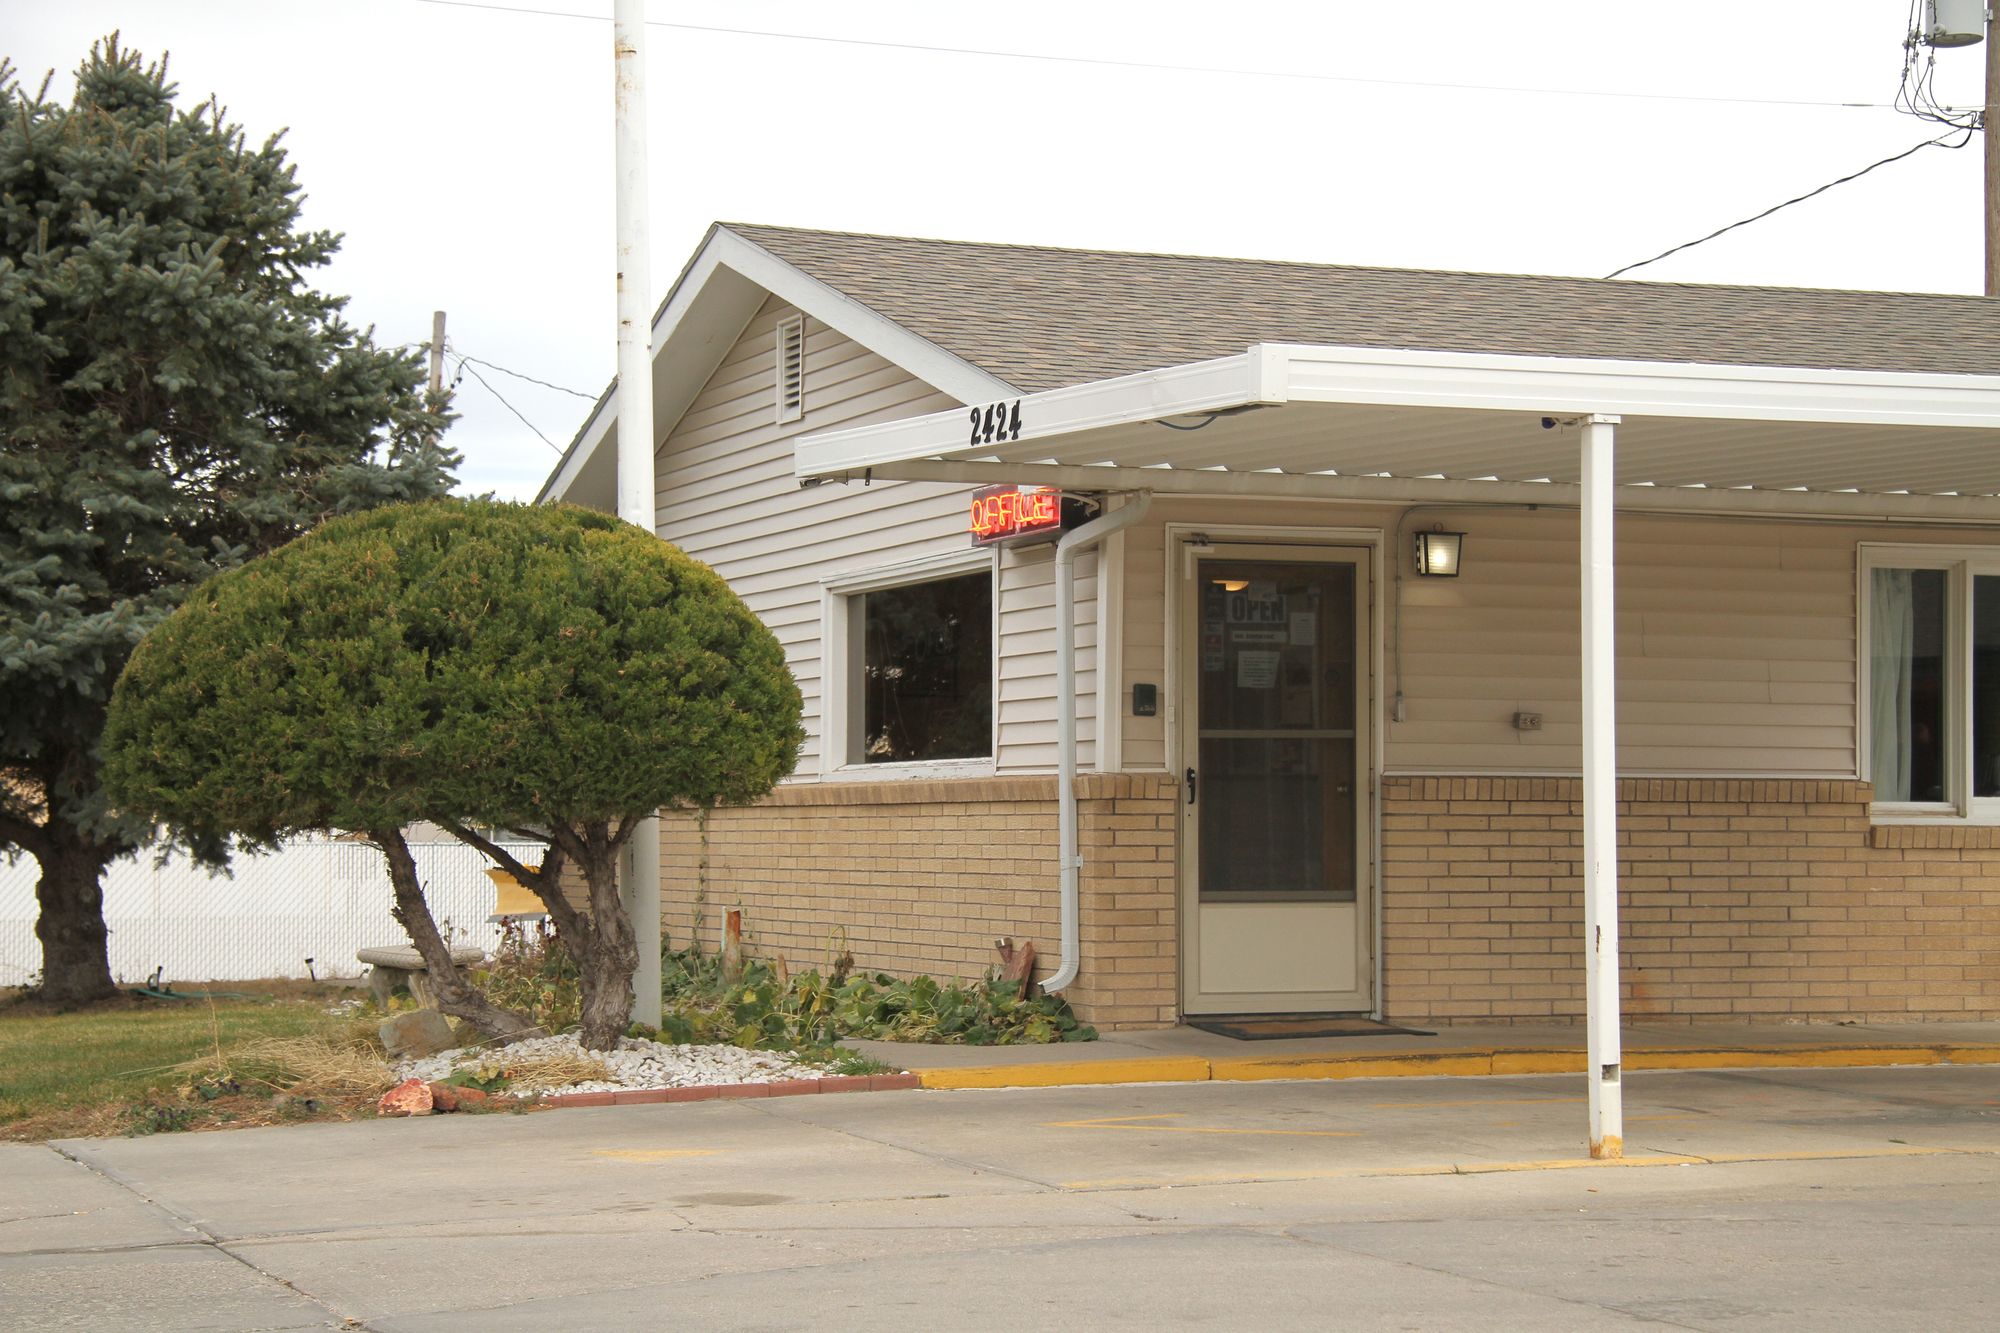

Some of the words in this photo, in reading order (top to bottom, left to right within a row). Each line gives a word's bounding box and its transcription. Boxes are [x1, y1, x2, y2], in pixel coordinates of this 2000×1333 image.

[970, 400, 1022, 446] 2424
[969, 487, 1055, 533] OFFICE
[1231, 594, 1284, 622] OPEN
